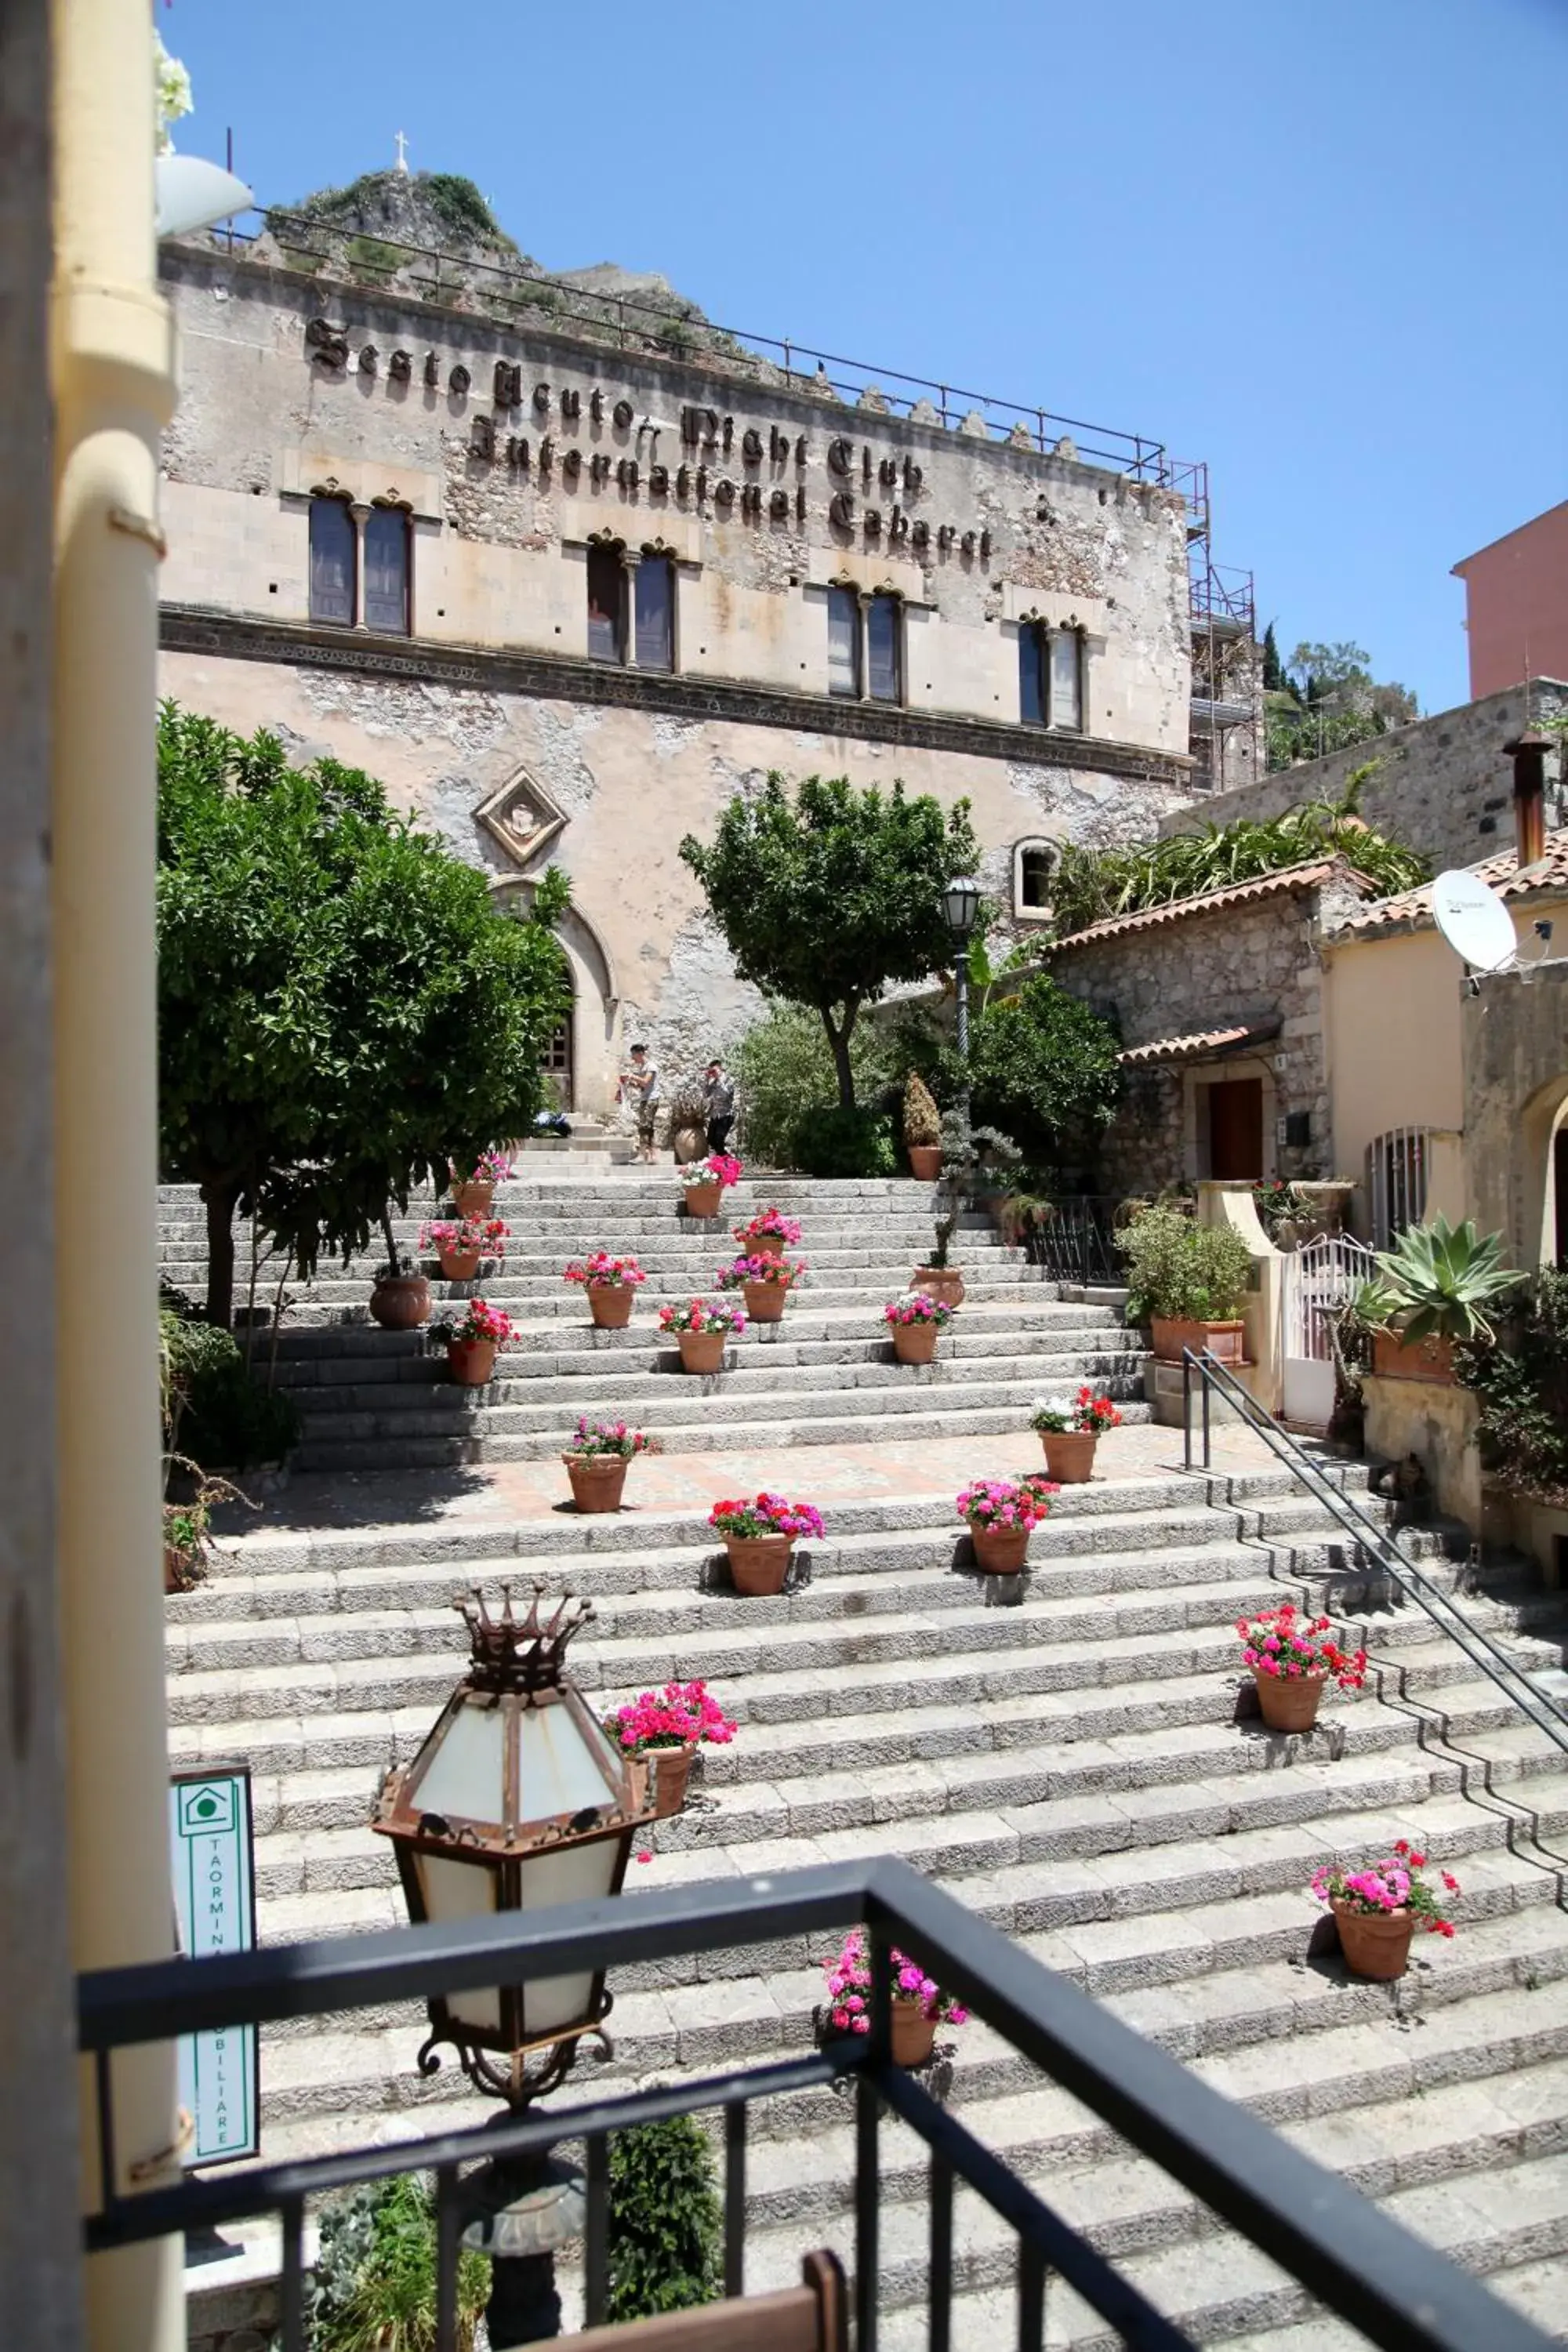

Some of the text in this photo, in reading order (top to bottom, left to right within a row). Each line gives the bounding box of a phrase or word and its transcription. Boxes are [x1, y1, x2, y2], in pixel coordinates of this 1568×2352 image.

[306, 318, 471, 394] Sesto
[681, 405, 810, 467] Night
[828, 436, 923, 491] Club
[470, 414, 992, 558] International Cabaret
